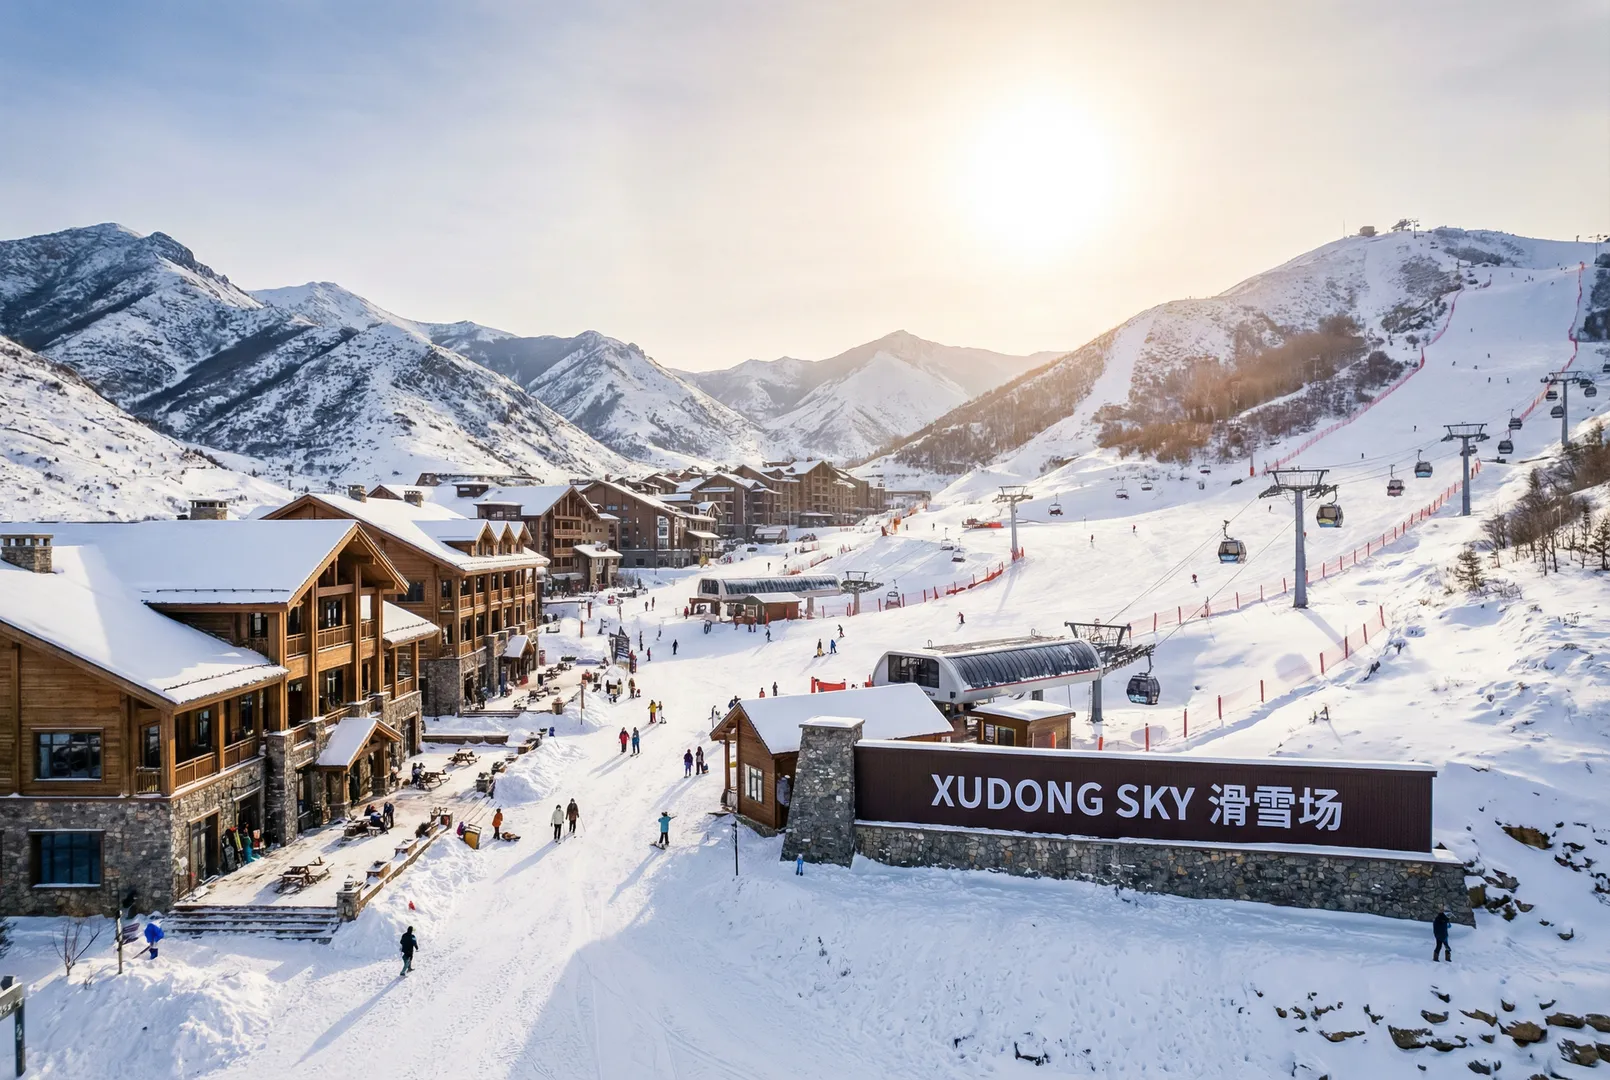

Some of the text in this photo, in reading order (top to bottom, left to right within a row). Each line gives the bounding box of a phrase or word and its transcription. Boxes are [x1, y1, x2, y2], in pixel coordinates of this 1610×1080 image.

[931, 774, 1343, 831] XUDONG SKY 滑雪场
